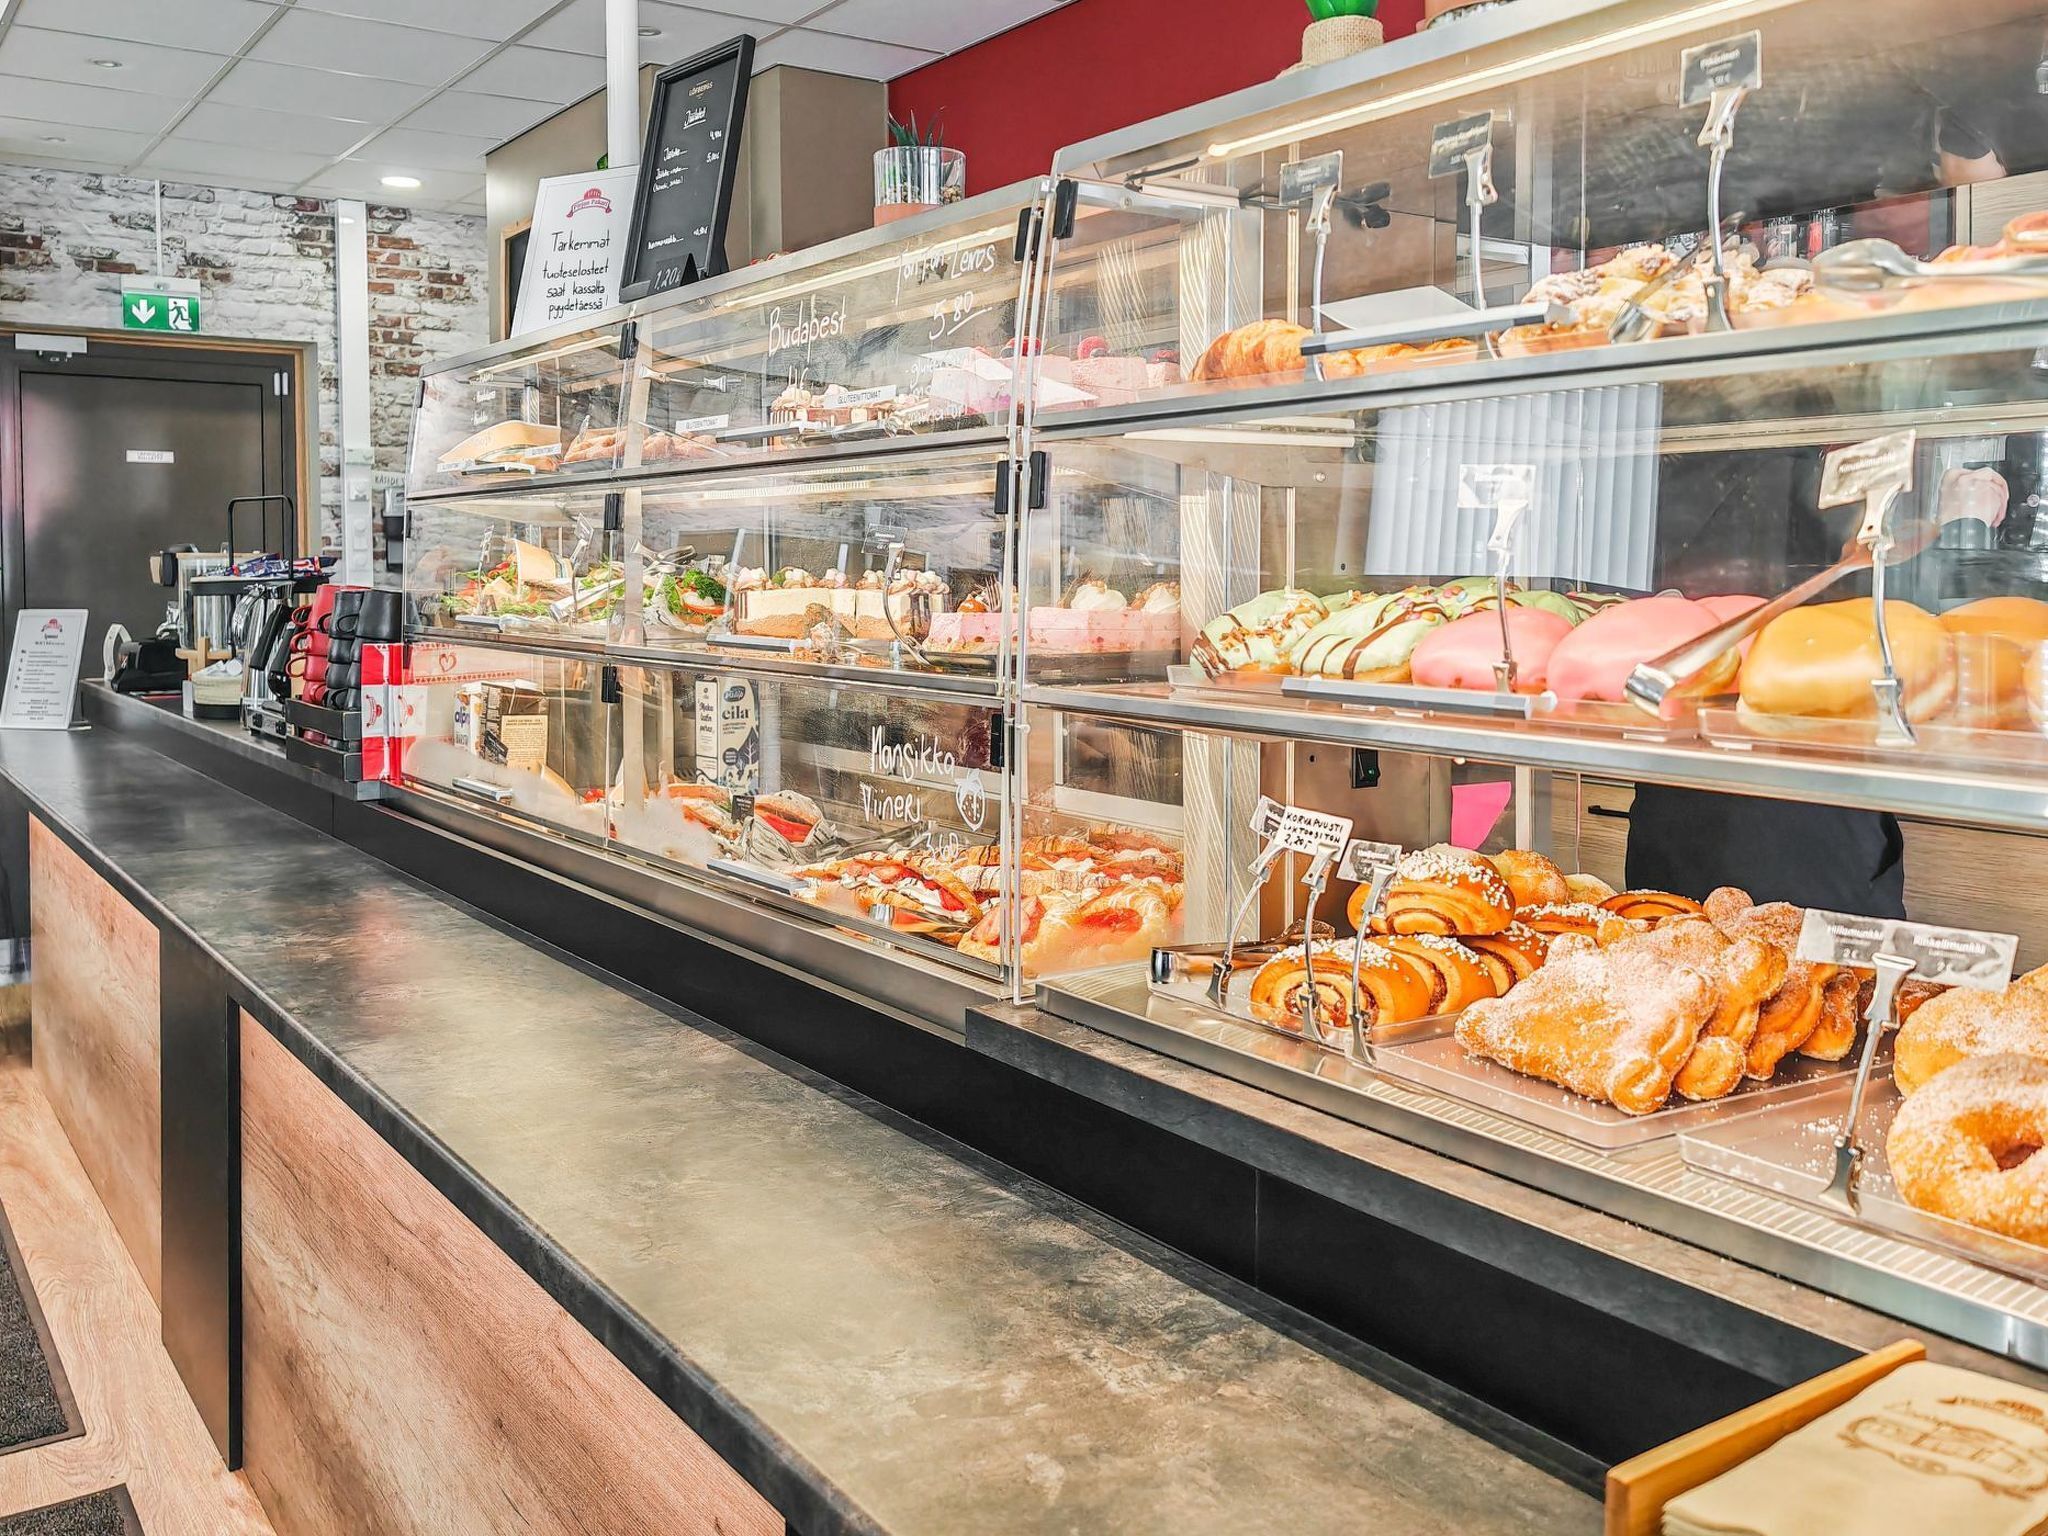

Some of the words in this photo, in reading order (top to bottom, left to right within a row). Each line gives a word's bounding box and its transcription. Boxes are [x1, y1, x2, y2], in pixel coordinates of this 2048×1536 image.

[552, 229, 610, 252] Tarkemmat
[542, 257, 609, 279] tuoteselosteet
[546, 283, 566, 298] saat
[572, 279, 605, 295] kassalta
[769, 294, 847, 364] Budapest
[722, 705, 749, 720] eila
[871, 725, 955, 783] Mansikka
[1286, 811, 1344, 833] KORVAPUUSTI
[1283, 824, 1341, 844] LAKTOOSITON
